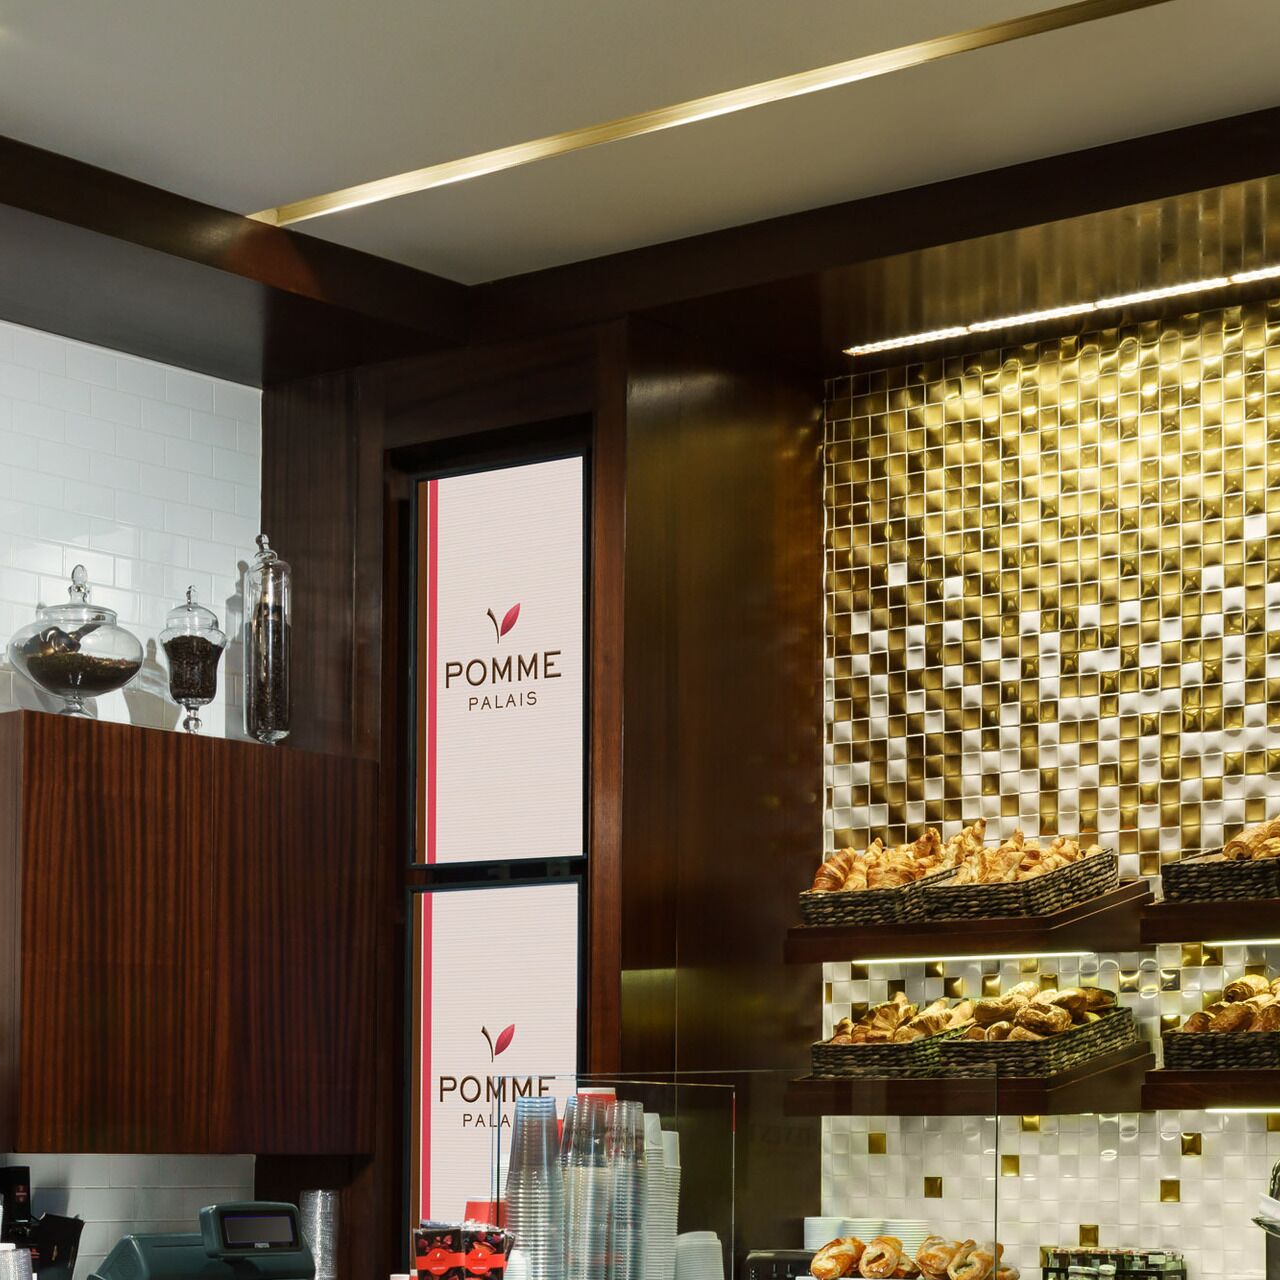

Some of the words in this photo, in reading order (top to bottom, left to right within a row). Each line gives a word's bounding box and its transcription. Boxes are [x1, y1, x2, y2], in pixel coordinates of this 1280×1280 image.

[445, 650, 562, 689] POMME
[468, 691, 538, 712] PALAIS
[439, 1075, 556, 1103] POMME
[462, 1113, 511, 1128] PALA
